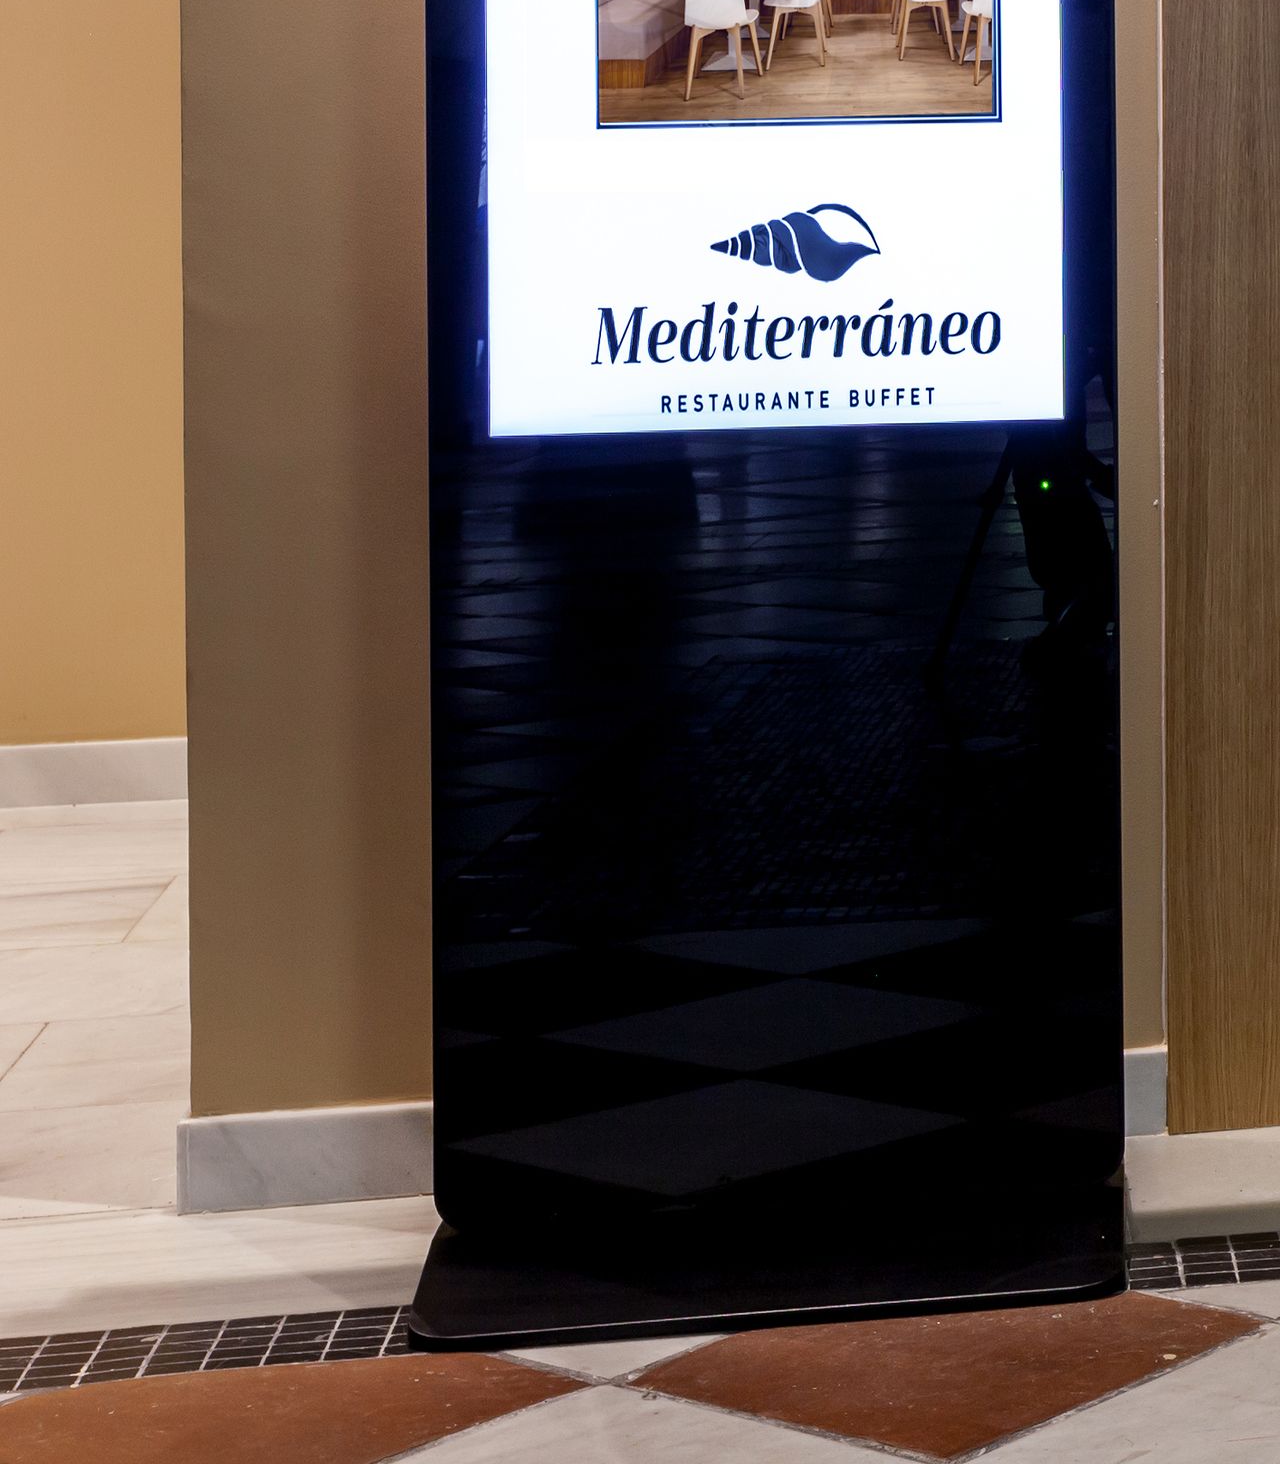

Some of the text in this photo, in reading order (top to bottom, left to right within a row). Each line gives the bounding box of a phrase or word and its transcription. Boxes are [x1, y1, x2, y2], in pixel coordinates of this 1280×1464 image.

[591, 298, 1001, 365] Mediterráneo
[661, 387, 935, 414] RESTAURANTE BUFFET
